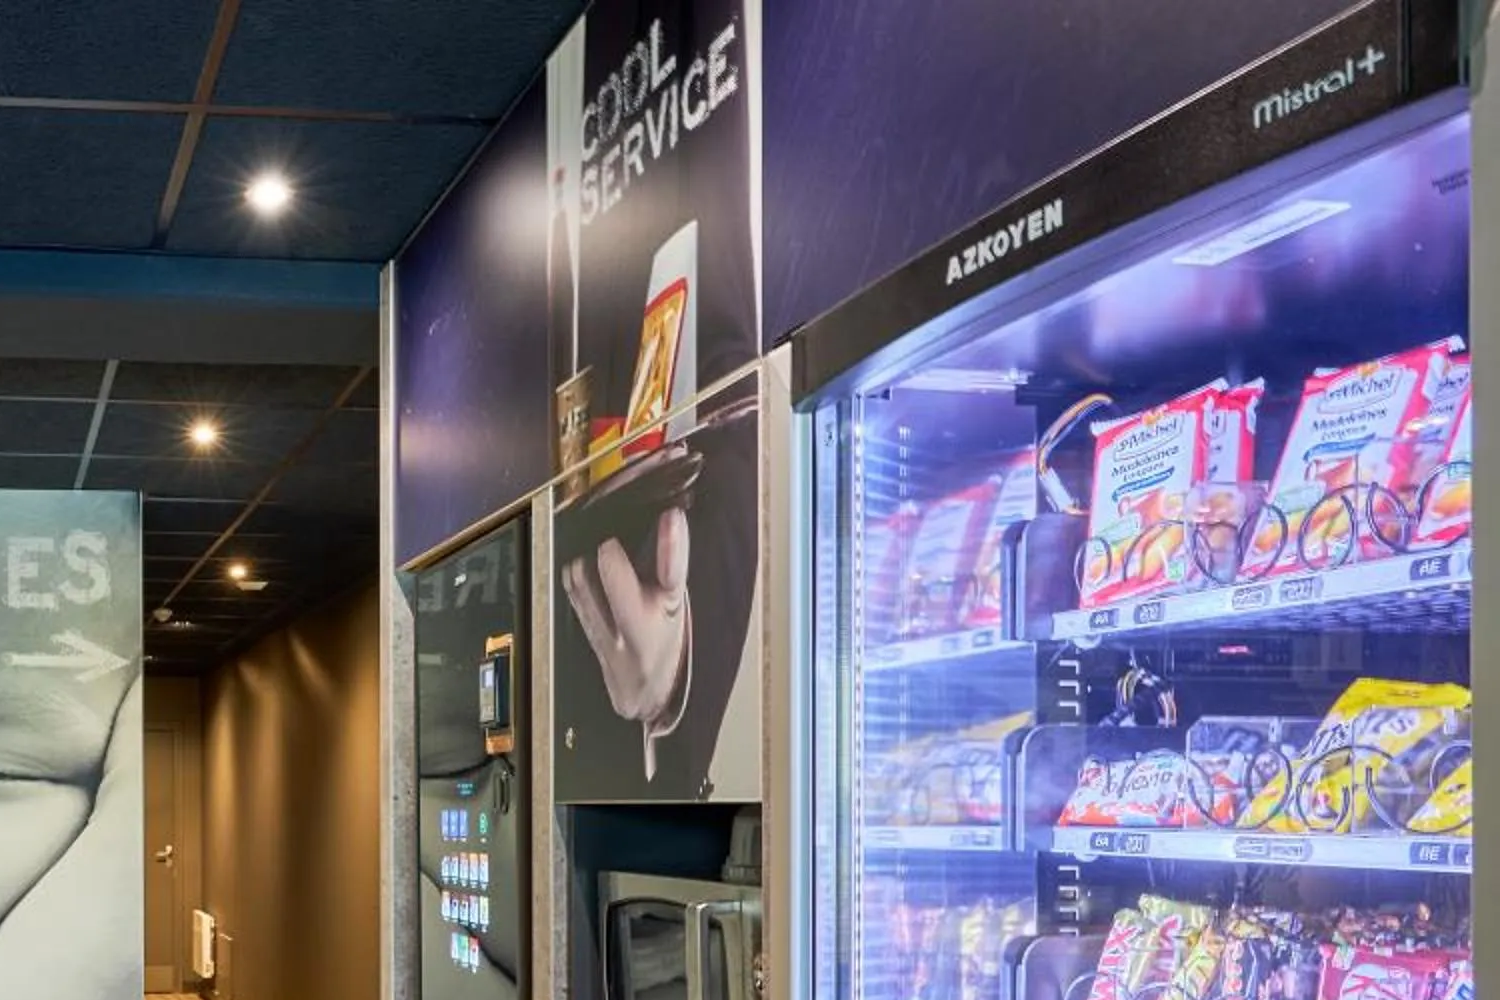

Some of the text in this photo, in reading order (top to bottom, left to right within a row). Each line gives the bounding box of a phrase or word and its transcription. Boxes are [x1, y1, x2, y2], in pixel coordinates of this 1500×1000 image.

[581, 22, 739, 225] SERVICE
[582, 18, 677, 162] COOL
[945, 198, 1063, 286] AZKOYEN
